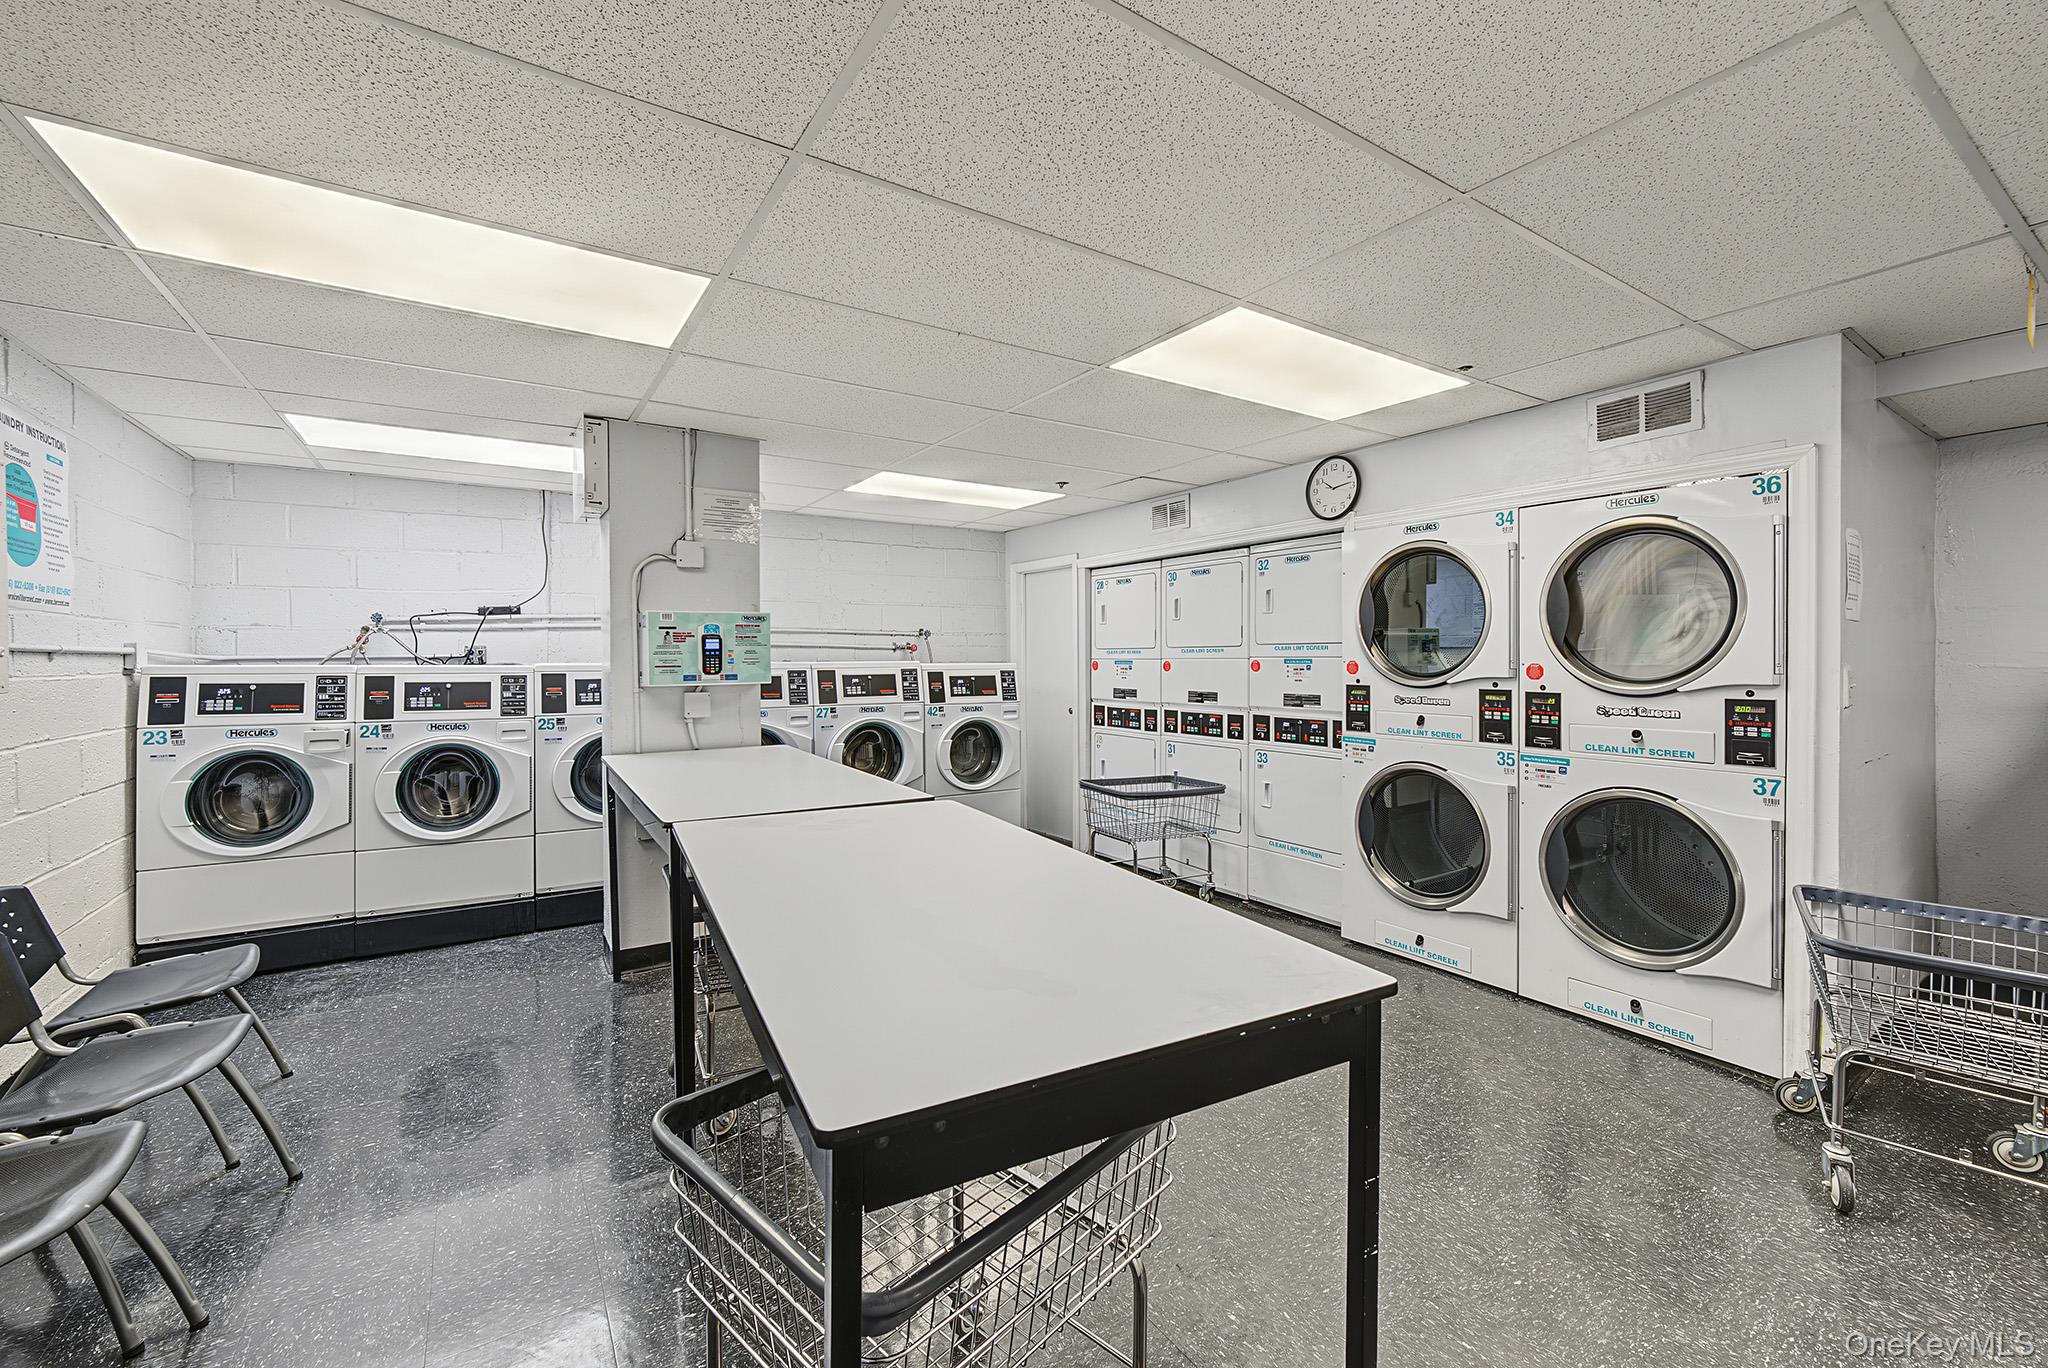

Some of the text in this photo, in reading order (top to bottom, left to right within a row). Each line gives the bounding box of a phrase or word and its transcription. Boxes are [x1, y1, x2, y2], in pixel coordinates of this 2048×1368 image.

[1610, 476, 1781, 508] Hercules 36
[1405, 511, 1515, 533] Hercules 34
[1258, 560, 1269, 571] 32
[1168, 572, 1177, 582] 30
[1394, 695, 1450, 706] Speed Queen
[816, 707, 829, 719] 27
[927, 706, 938, 716] 42
[1596, 705, 1681, 719] Speed Queen
[359, 723, 467, 739] 24 Hercules
[538, 718, 555, 731] 25
[142, 729, 275, 746] 23 Hercules
[1388, 727, 1411, 735] CLEAN
[1431, 731, 1462, 739] SCREEN
[1167, 744, 1176, 754] 31
[1585, 744, 1695, 759] CLEAN LINT SCREEN
[1257, 752, 1268, 763] 33
[1496, 751, 1516, 767] 35
[1753, 777, 1781, 797] 37
[1385, 938, 1458, 967] CLEAN LINT SCREEN
[1584, 1001, 1694, 1042] CLEAN LINT SCREEN
